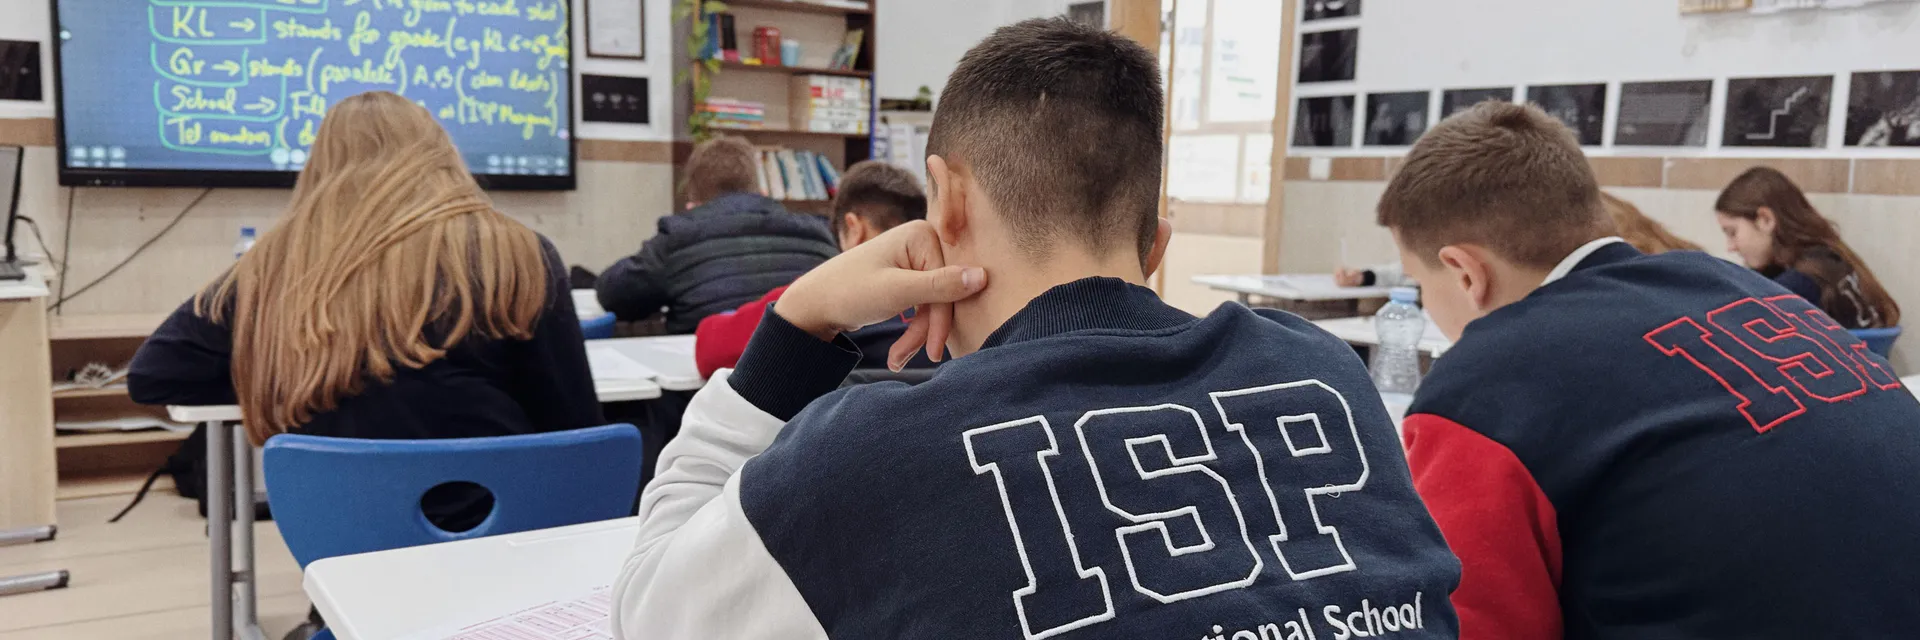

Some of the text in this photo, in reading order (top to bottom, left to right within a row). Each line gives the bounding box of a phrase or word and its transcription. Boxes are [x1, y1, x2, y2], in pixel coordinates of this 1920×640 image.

[171, 85, 237, 114] School
[1643, 294, 1900, 433] ISP
[963, 379, 1369, 640] ISP
[1201, 591, 1423, 640] nal School
